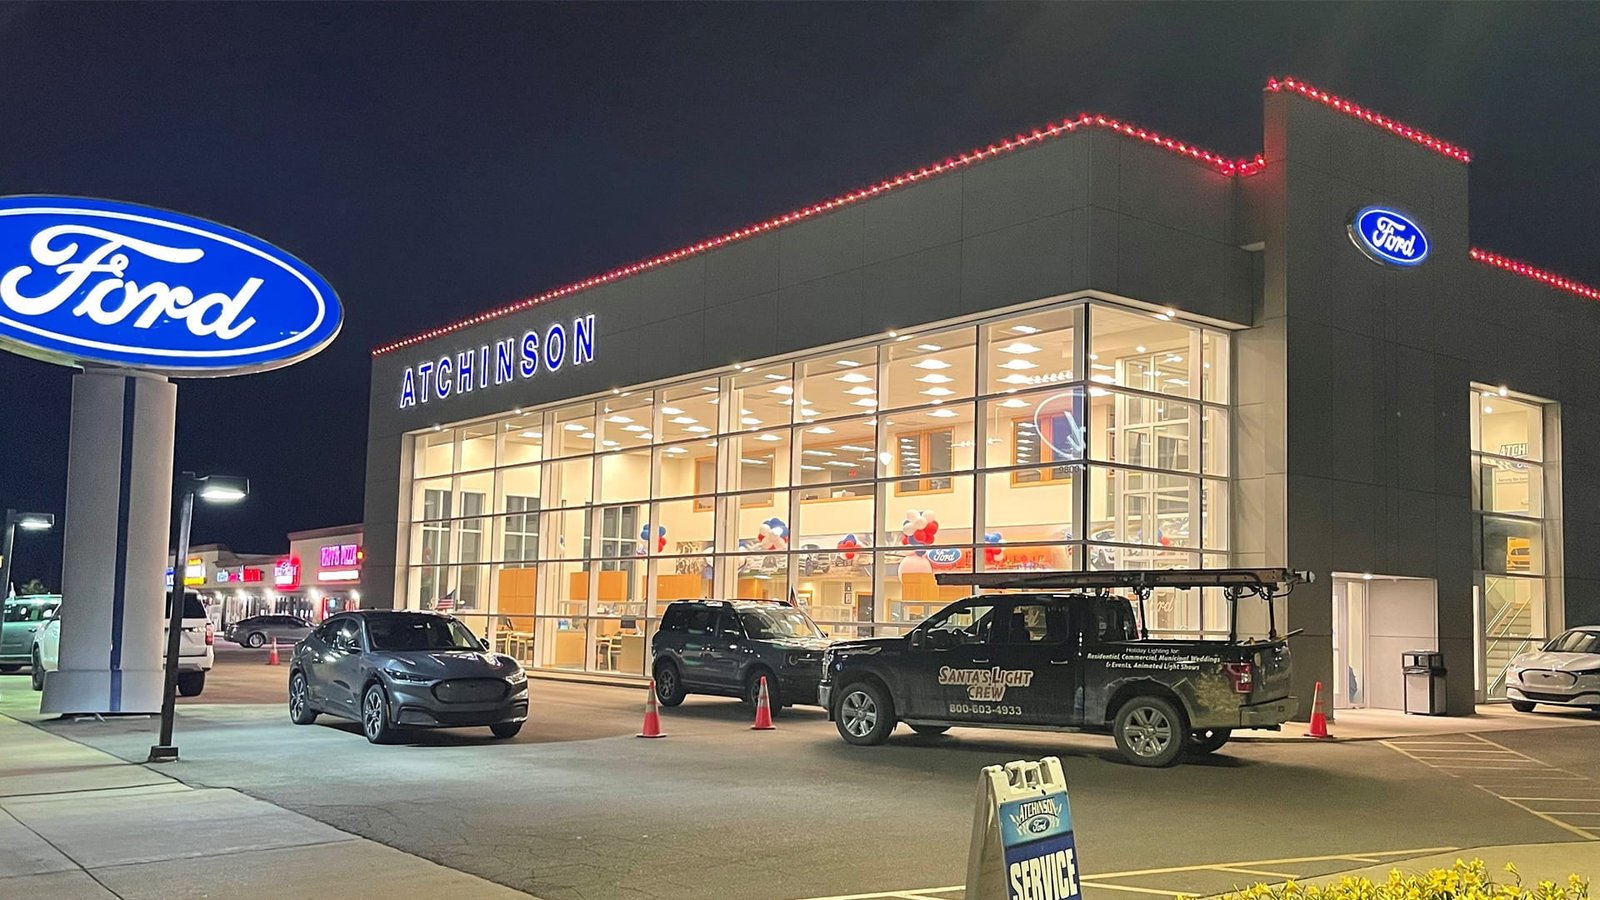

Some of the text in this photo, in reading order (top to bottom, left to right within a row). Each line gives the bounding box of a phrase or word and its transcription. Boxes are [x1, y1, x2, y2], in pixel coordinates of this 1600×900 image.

[1372, 216, 1416, 257] Ford
[0, 224, 264, 340] Ford
[400, 314, 595, 409] ATCHINSON
[933, 549, 955, 562] Ford
[939, 666, 1033, 686] SANTA'S LIGHT
[1164, 663, 1179, 671] Light
[967, 686, 1005, 701] CREW
[949, 704, 1022, 715] 800-603-4933
[1020, 798, 1058, 821] ATCHINSON
[1010, 848, 1078, 900] SERVICE
